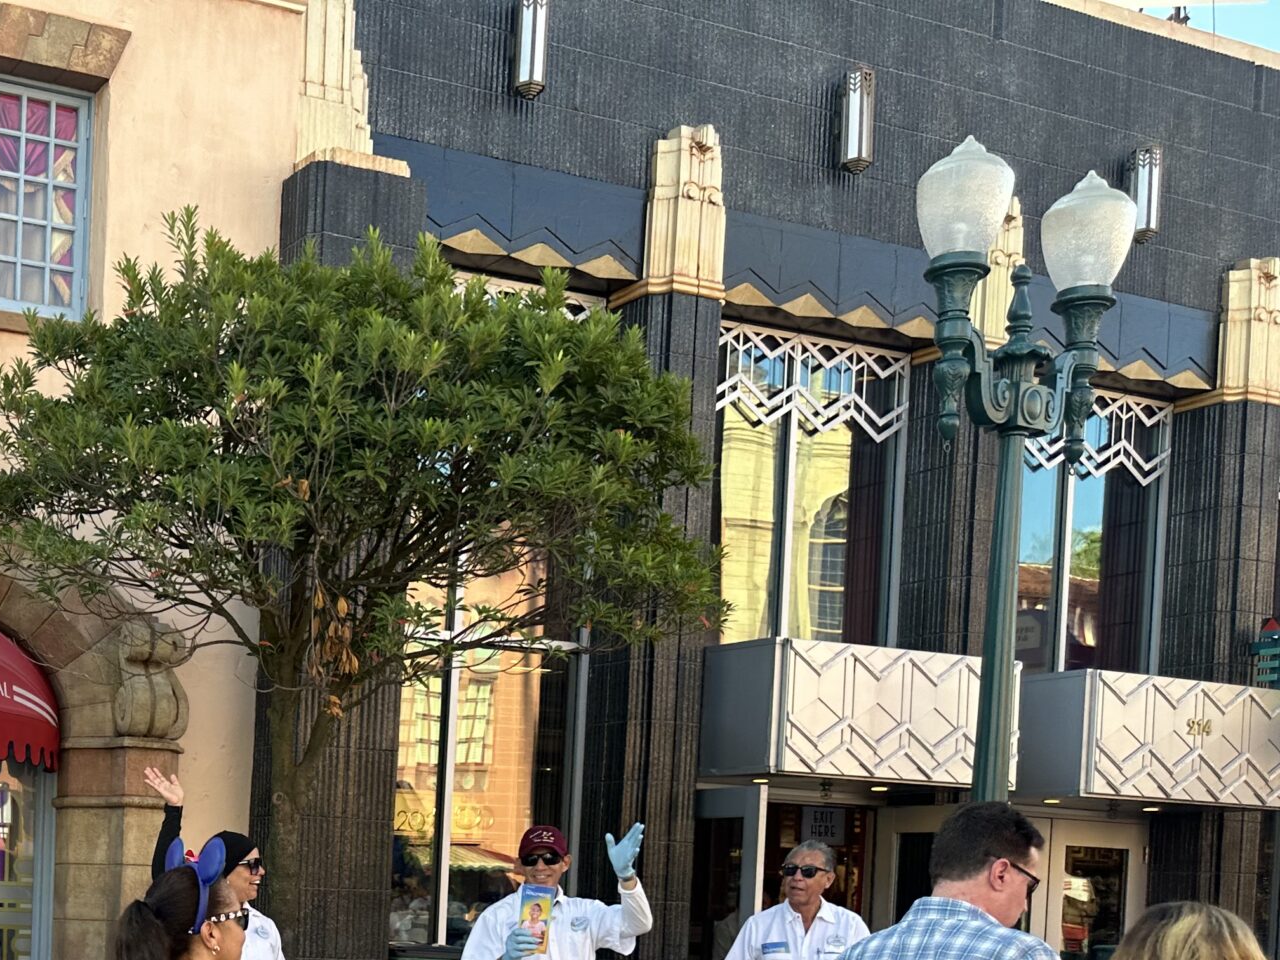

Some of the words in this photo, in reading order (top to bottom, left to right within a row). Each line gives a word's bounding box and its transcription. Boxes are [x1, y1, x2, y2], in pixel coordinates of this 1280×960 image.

[1186, 718, 1212, 737] 214
[813, 810, 835, 825] EXIT
[810, 824, 836, 838] HERE
